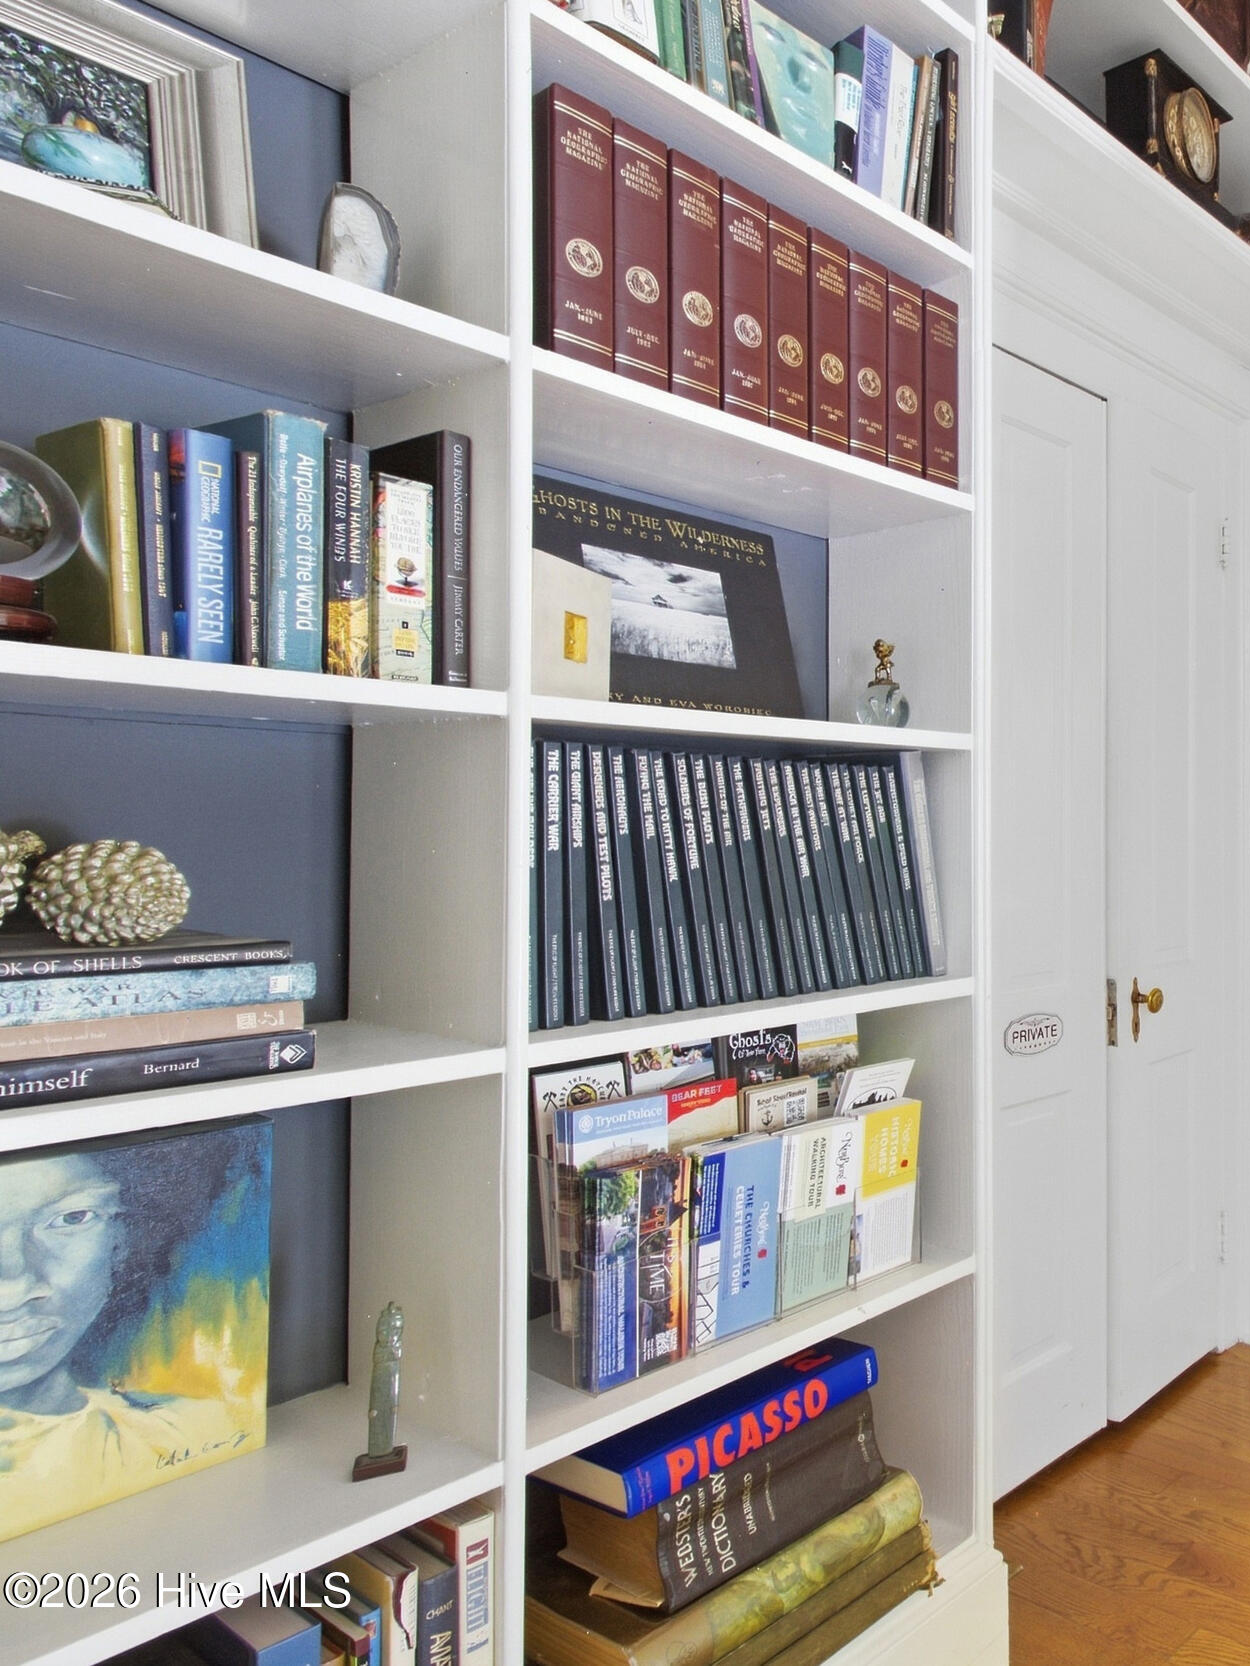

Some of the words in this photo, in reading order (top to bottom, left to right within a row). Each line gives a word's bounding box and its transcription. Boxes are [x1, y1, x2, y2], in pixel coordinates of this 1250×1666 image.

[248, 456, 257, 469] The
[335, 459, 347, 482] THE
[453, 444, 463, 470] OUR
[200, 477, 212, 523] GEOGRAPHIC
[211, 478, 221, 514] NATIONAL
[292, 453, 318, 532] Airplanes
[350, 463, 362, 508] KRISTIN
[335, 485, 347, 519] FOUR
[452, 472, 464, 534] ENDANGERED
[296, 534, 317, 554] of
[335, 523, 347, 563] WINDS
[350, 512, 362, 565] HANNAH
[604, 506, 622, 521] IN
[627, 511, 662, 531] THE
[664, 519, 765, 555] WILDERNESS
[197, 527, 224, 595] RARELY
[452, 536, 464, 572] VALUES
[680, 541, 767, 567] AMERICA
[296, 556, 317, 582] the
[296, 584, 317, 632] World
[452, 585, 464, 618] JIMMY
[197, 598, 224, 644] SEEN
[452, 619, 464, 656] CARTER
[632, 695, 662, 704] AND
[669, 699, 697, 709] EVA
[547, 750, 559, 772] THE
[570, 750, 581, 770] THE
[613, 755, 623, 774] THE
[638, 755, 650, 790] FLYING
[654, 758, 664, 778] THE
[695, 759, 705, 780] THE
[733, 763, 743, 781] THE
[571, 771, 582, 802] GIANT
[592, 751, 604, 809] DESIGNERS
[677, 759, 691, 806] SOLDIERS
[753, 762, 768, 807] FIGHTING
[768, 766, 778, 785] THE
[783, 765, 798, 806] AMERICA
[802, 767, 810, 785] THE
[814, 768, 824, 803] WOMEN
[859, 771, 867, 790] THE
[547, 774, 559, 822] CARRIER
[614, 775, 628, 836] AERONAUTS
[642, 792, 653, 812] THE
[656, 778, 668, 806] ROAD
[697, 781, 709, 808] BUSH
[720, 800, 728, 812] OF
[831, 769, 841, 788] THE
[840, 820, 850, 842] WAR
[571, 802, 583, 848] AIRSHIPS
[596, 810, 607, 835] AND
[660, 808, 670, 821] TO
[683, 808, 693, 822] OF
[721, 812, 731, 831] THE
[735, 782, 751, 842] PATHFINDERS
[760, 807, 771, 831] JETS
[790, 806, 800, 818] IN
[547, 824, 559, 851] WAR
[644, 814, 656, 840] MAIL
[661, 822, 674, 851] KITTY
[700, 809, 714, 845] PILOTS
[723, 831, 732, 847] AIR
[793, 819, 803, 838] THE
[599, 836, 609, 863] TEST
[685, 822, 700, 870] FORTUNE
[796, 838, 806, 855] AIR
[665, 852, 679, 882] HAWK
[799, 854, 810, 879] WAR
[601, 864, 613, 902] PILOTS
[33, 960, 59, 975] OF
[73, 955, 143, 973] SHELLS
[174, 952, 238, 965] CRESCENT
[1012, 1024, 1058, 1044] PRIVATE
[144, 1057, 201, 1075] Bernard
[595, 1112, 627, 1129] Tryon
[627, 1105, 663, 1121] Palace
[810, 1138, 819, 1180] WALKING
[815, 1137, 826, 1209] ARCHITECTURAL
[745, 1185, 754, 1209] THE
[733, 1185, 745, 1259] CEMETERIES
[742, 1212, 753, 1277] CHURCHES
[649, 1250, 665, 1298] TIME
[731, 1261, 741, 1296] TOUR
[666, 1378, 828, 1495] PICASSO
[709, 1472, 736, 1573] DICTIONARY
[676, 1494, 698, 1588] WEBSTER'S
